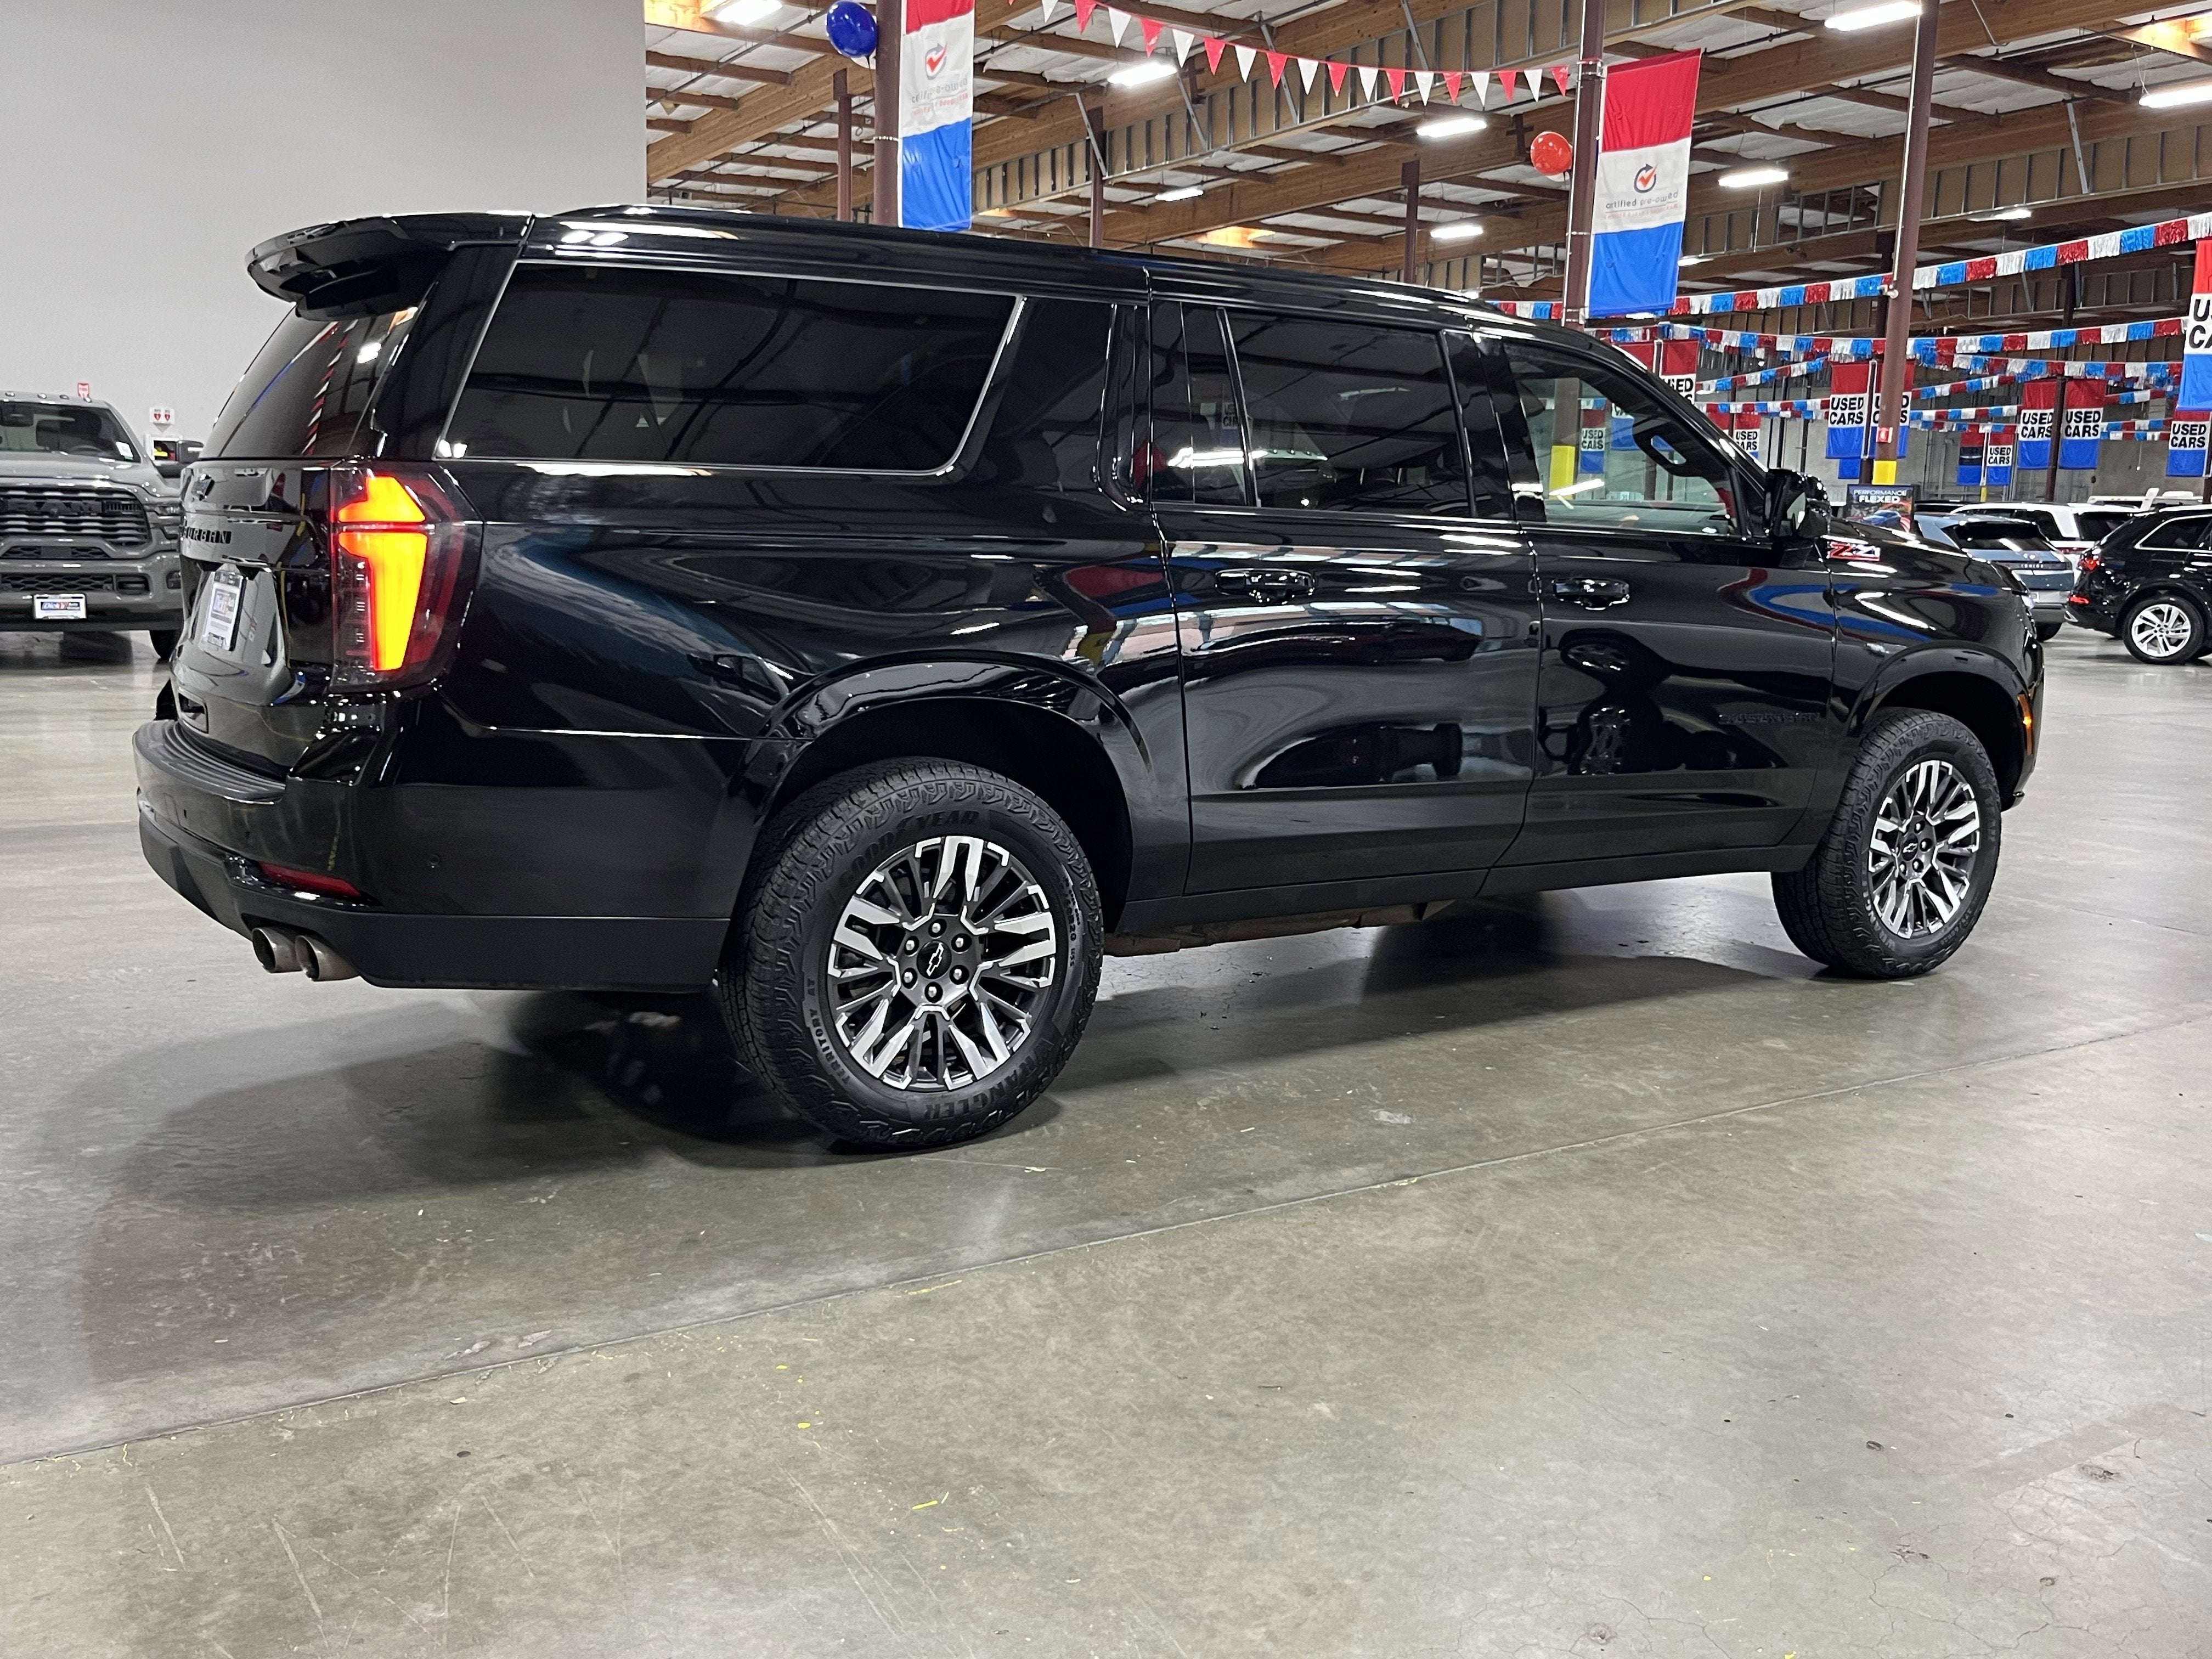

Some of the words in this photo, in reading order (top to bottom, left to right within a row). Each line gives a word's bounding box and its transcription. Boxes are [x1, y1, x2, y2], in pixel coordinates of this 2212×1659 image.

[1831, 397, 1864, 411] USED
[1830, 411, 1864, 425] CARS
[2022, 412, 2053, 425] USED
[2066, 410, 2101, 424] USED
[1583, 430, 1604, 439] USED
[1736, 431, 1758, 440] USED
[2021, 426, 2052, 438] CARS
[2064, 424, 2099, 437] CARS
[2172, 424, 2207, 436] USED
[2171, 436, 2205, 448] CARS
[1989, 447, 2011, 455] USED
[1988, 456, 2010, 465] CARS
[1859, 495, 1900, 503] FLEXED
[809, 1008, 850, 1085] TERRITORY
